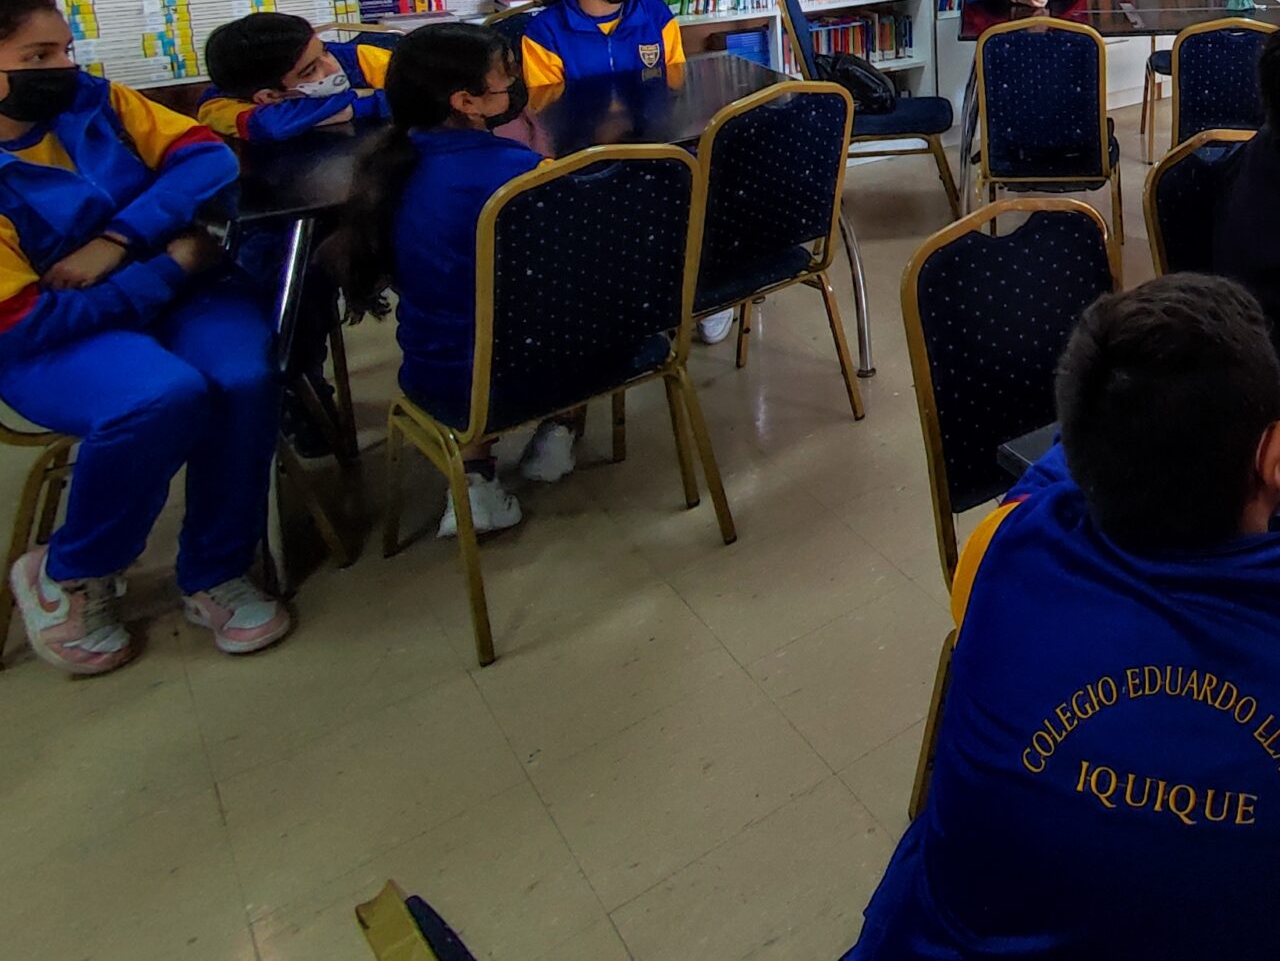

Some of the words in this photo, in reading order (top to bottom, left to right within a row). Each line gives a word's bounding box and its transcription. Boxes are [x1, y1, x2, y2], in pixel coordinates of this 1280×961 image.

[1022, 676, 1118, 773] COLEGIO
[1126, 665, 1257, 724] EDUARDO
[1076, 760, 1259, 825] IQUIQUE
